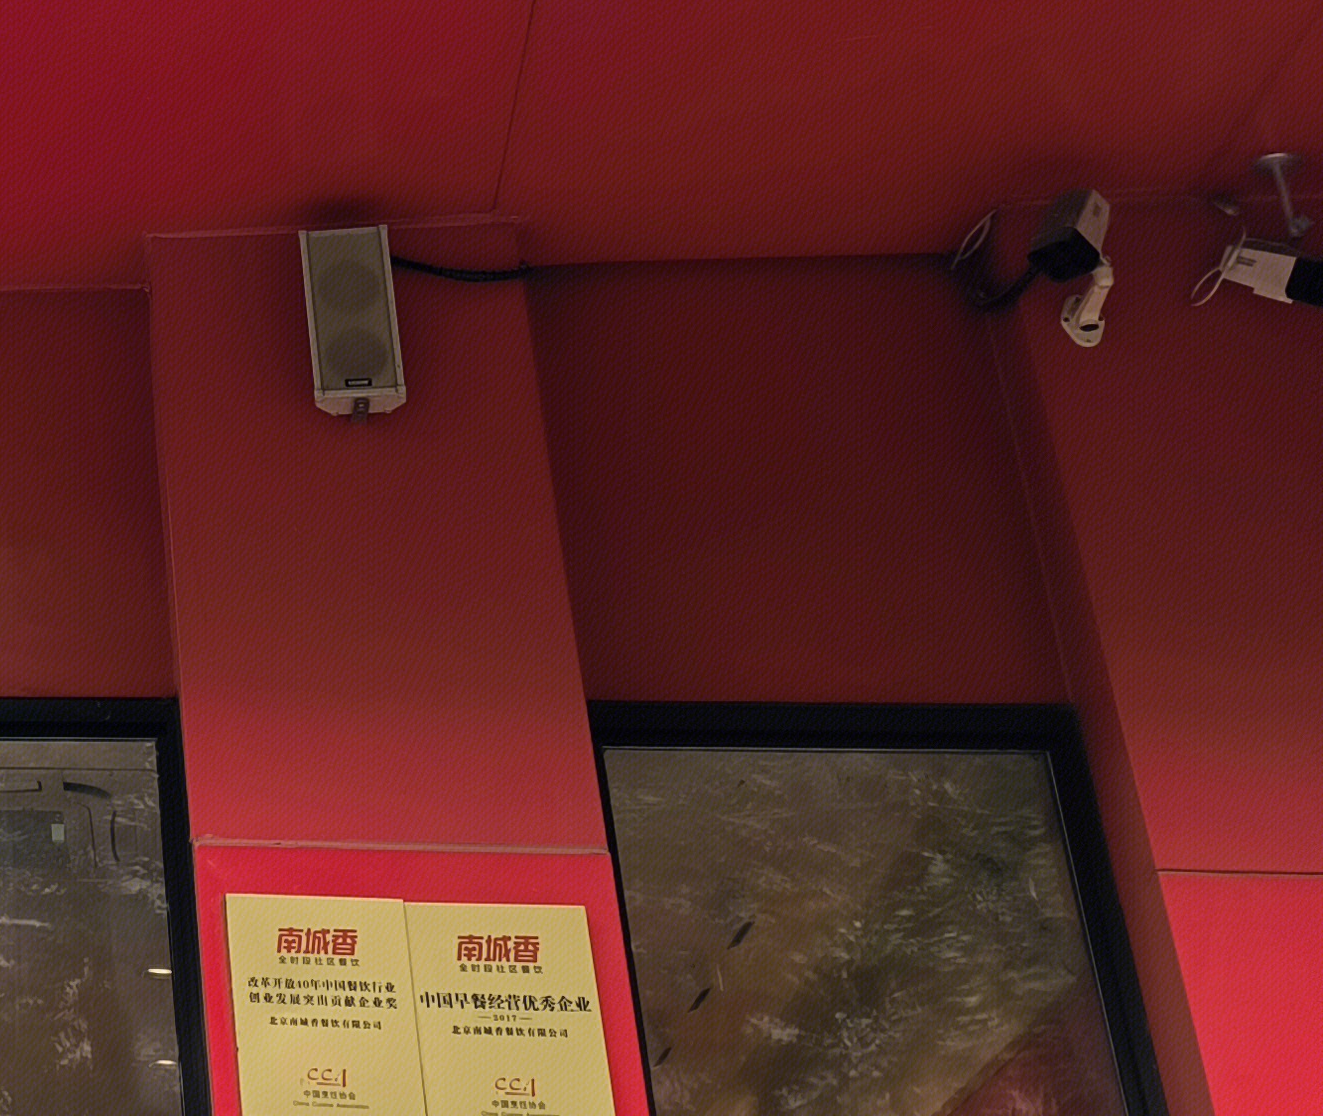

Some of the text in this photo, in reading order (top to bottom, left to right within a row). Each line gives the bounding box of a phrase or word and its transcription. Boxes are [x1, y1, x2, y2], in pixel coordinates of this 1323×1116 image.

[276, 927, 358, 956] 南城香
[456, 934, 540, 963] 南城香
[419, 991, 593, 1013] 中国早餐经营优秀企业
[269, 1016, 382, 1030] 北京南城香餐饮有限公司
[451, 1025, 569, 1038] 北京南城香餐饮有限公司
